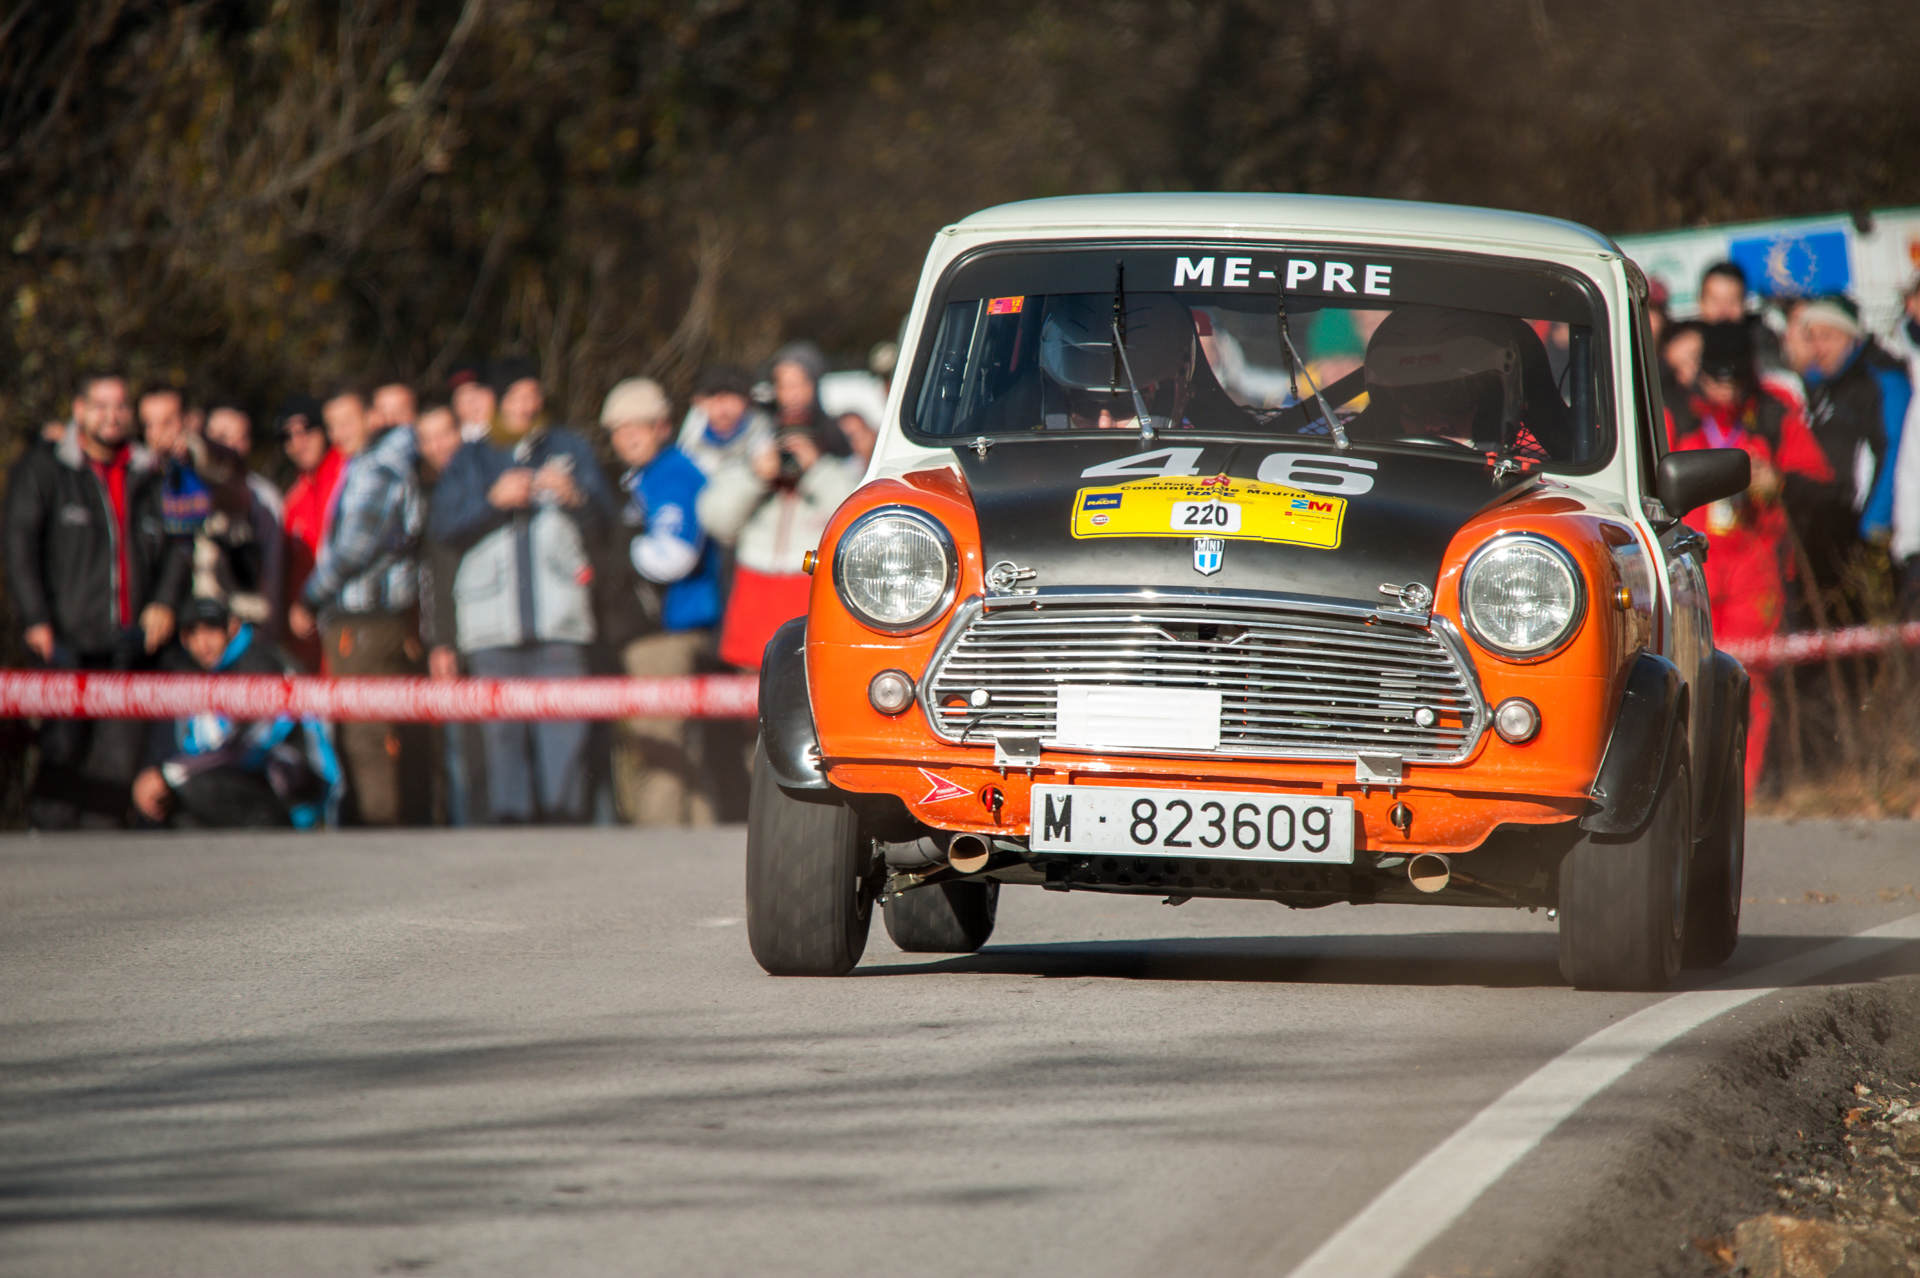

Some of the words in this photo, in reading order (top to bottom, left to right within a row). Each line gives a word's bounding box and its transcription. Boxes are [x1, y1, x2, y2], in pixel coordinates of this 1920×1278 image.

[1173, 257, 1393, 296] ME-PRE
[1080, 447, 1378, 496] 46
[1247, 489, 1306, 498] Madrid
[1183, 503, 1228, 527] 220
[1197, 539, 1221, 551] MINI
[1043, 793, 1073, 843] M
[1129, 798, 1332, 853] 823609
